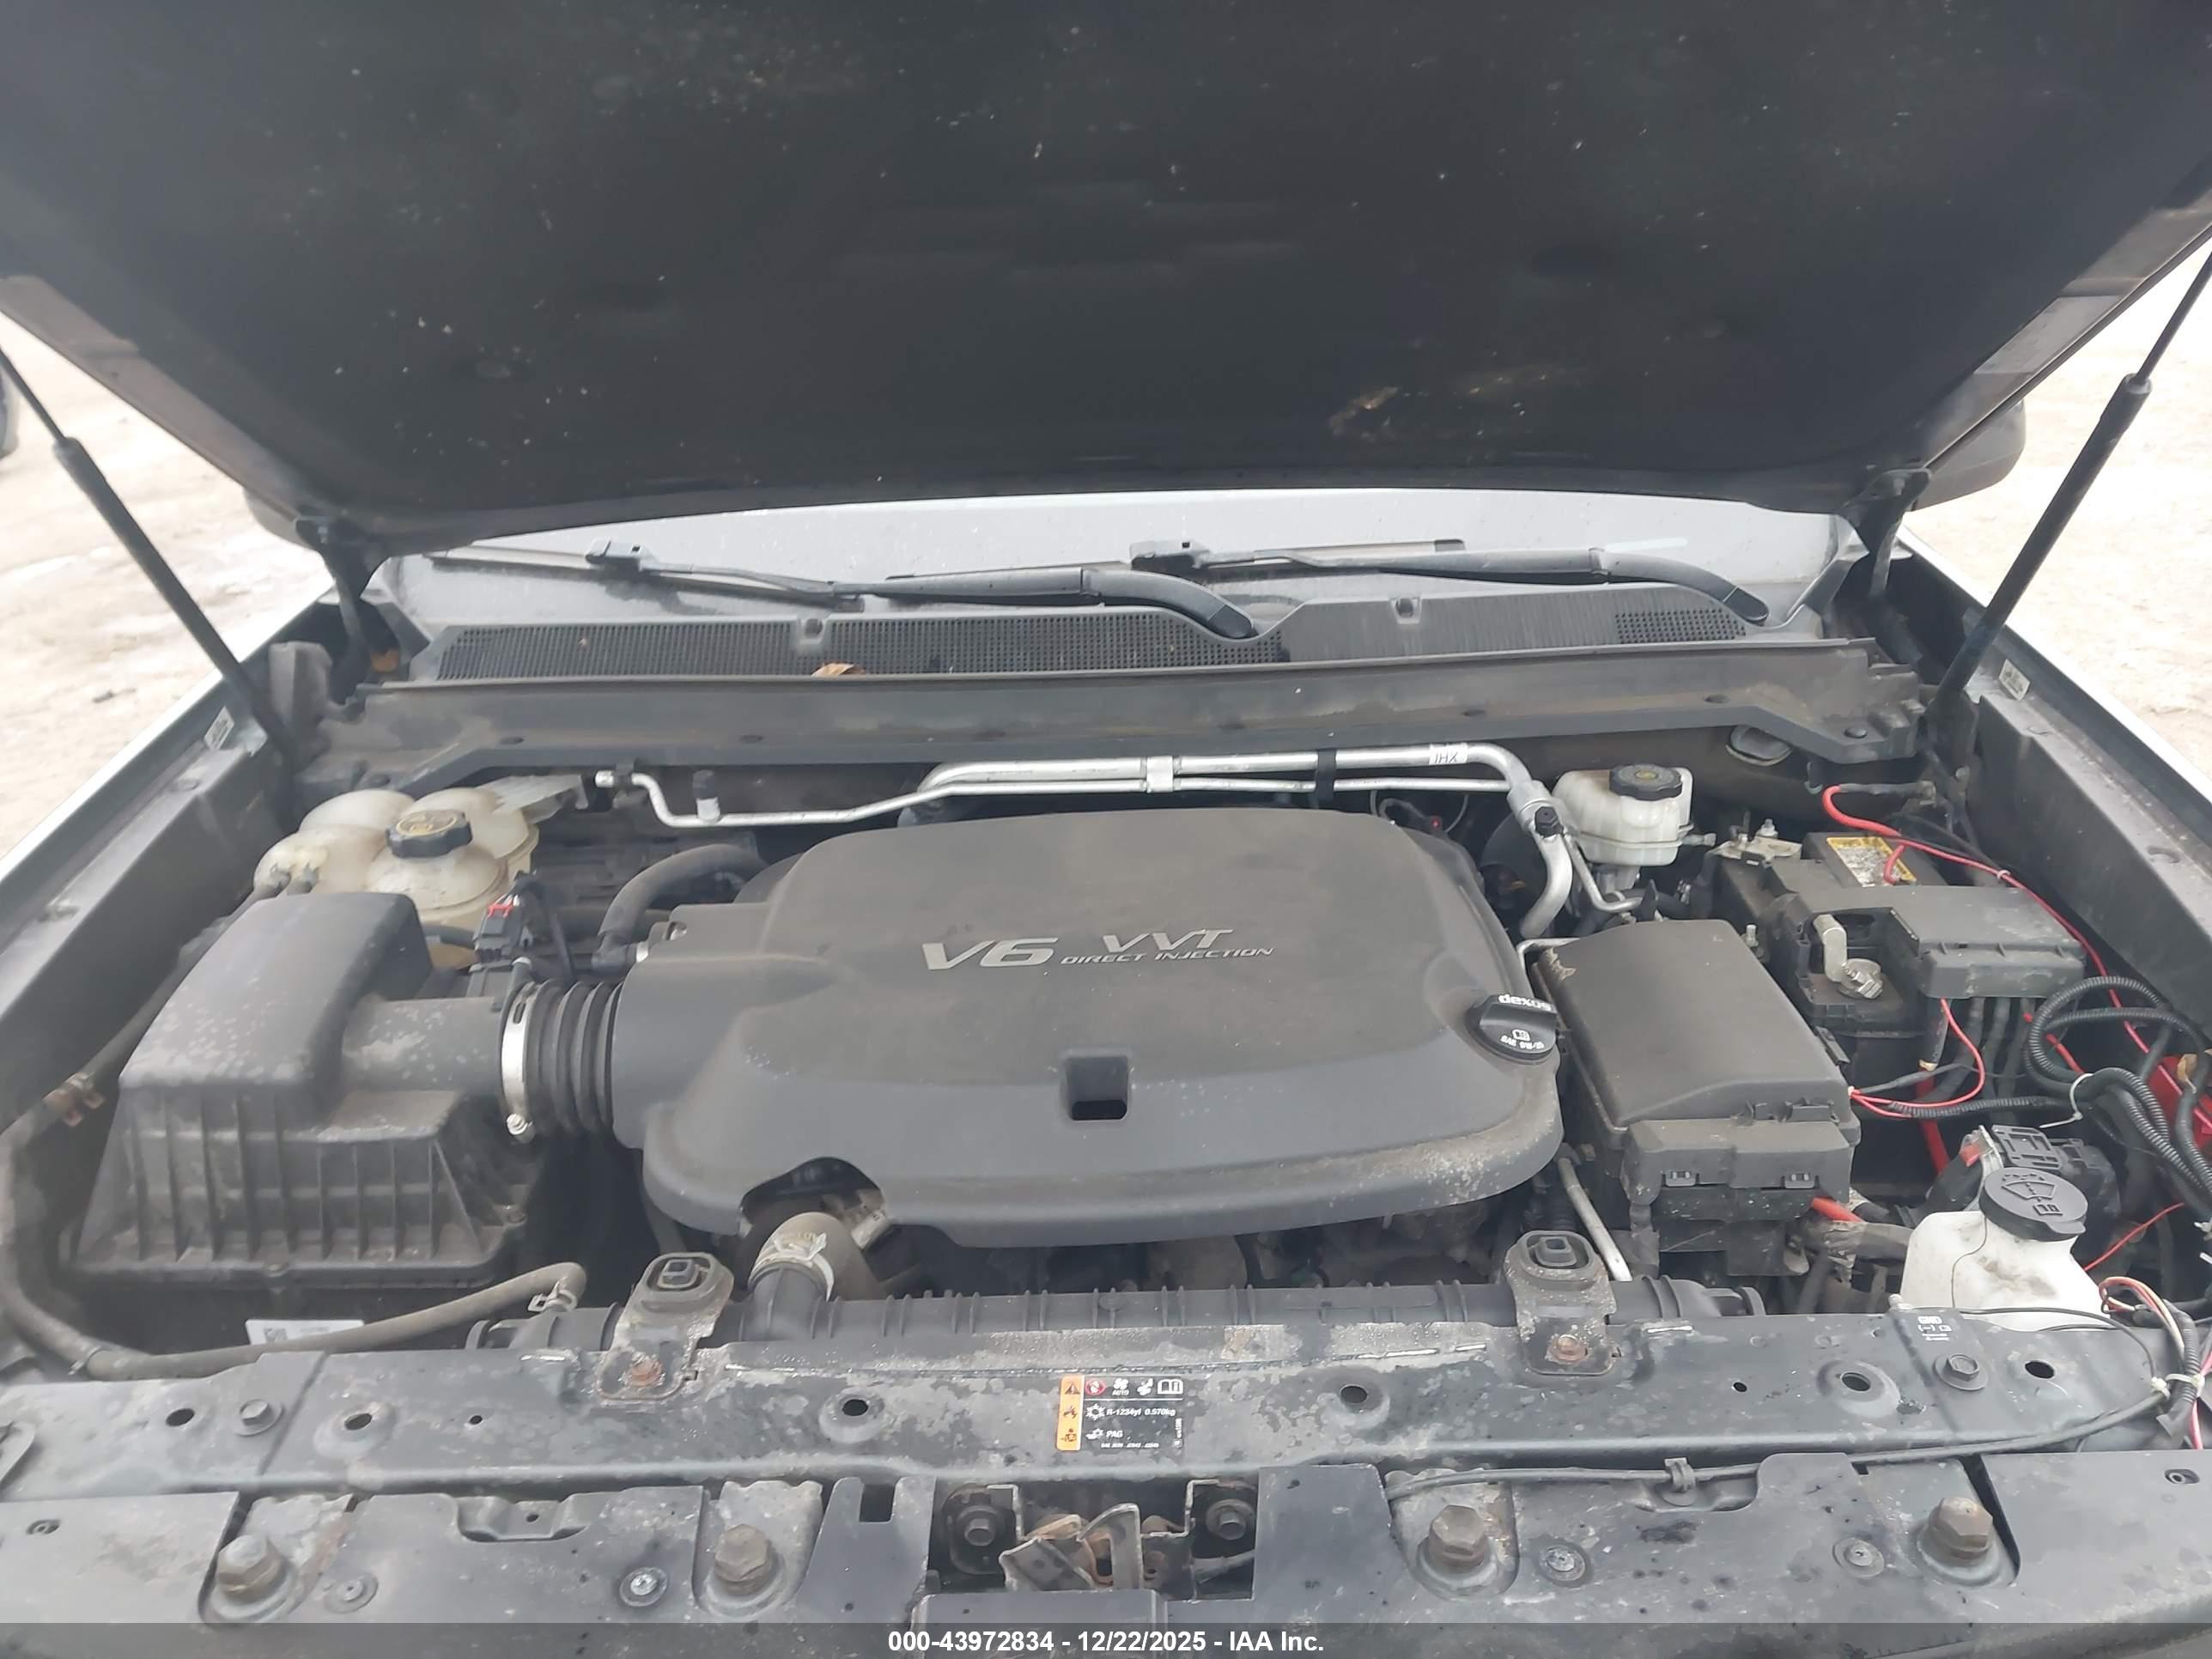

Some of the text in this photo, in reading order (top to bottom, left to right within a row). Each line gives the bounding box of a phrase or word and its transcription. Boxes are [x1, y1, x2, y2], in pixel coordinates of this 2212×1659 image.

[921, 929, 1233, 970] V6 VVT
[1060, 946, 1274, 965] DIRECT INJECTION
[1498, 994, 1552, 1012] dexos
[1105, 1429, 1123, 1438] PAG
